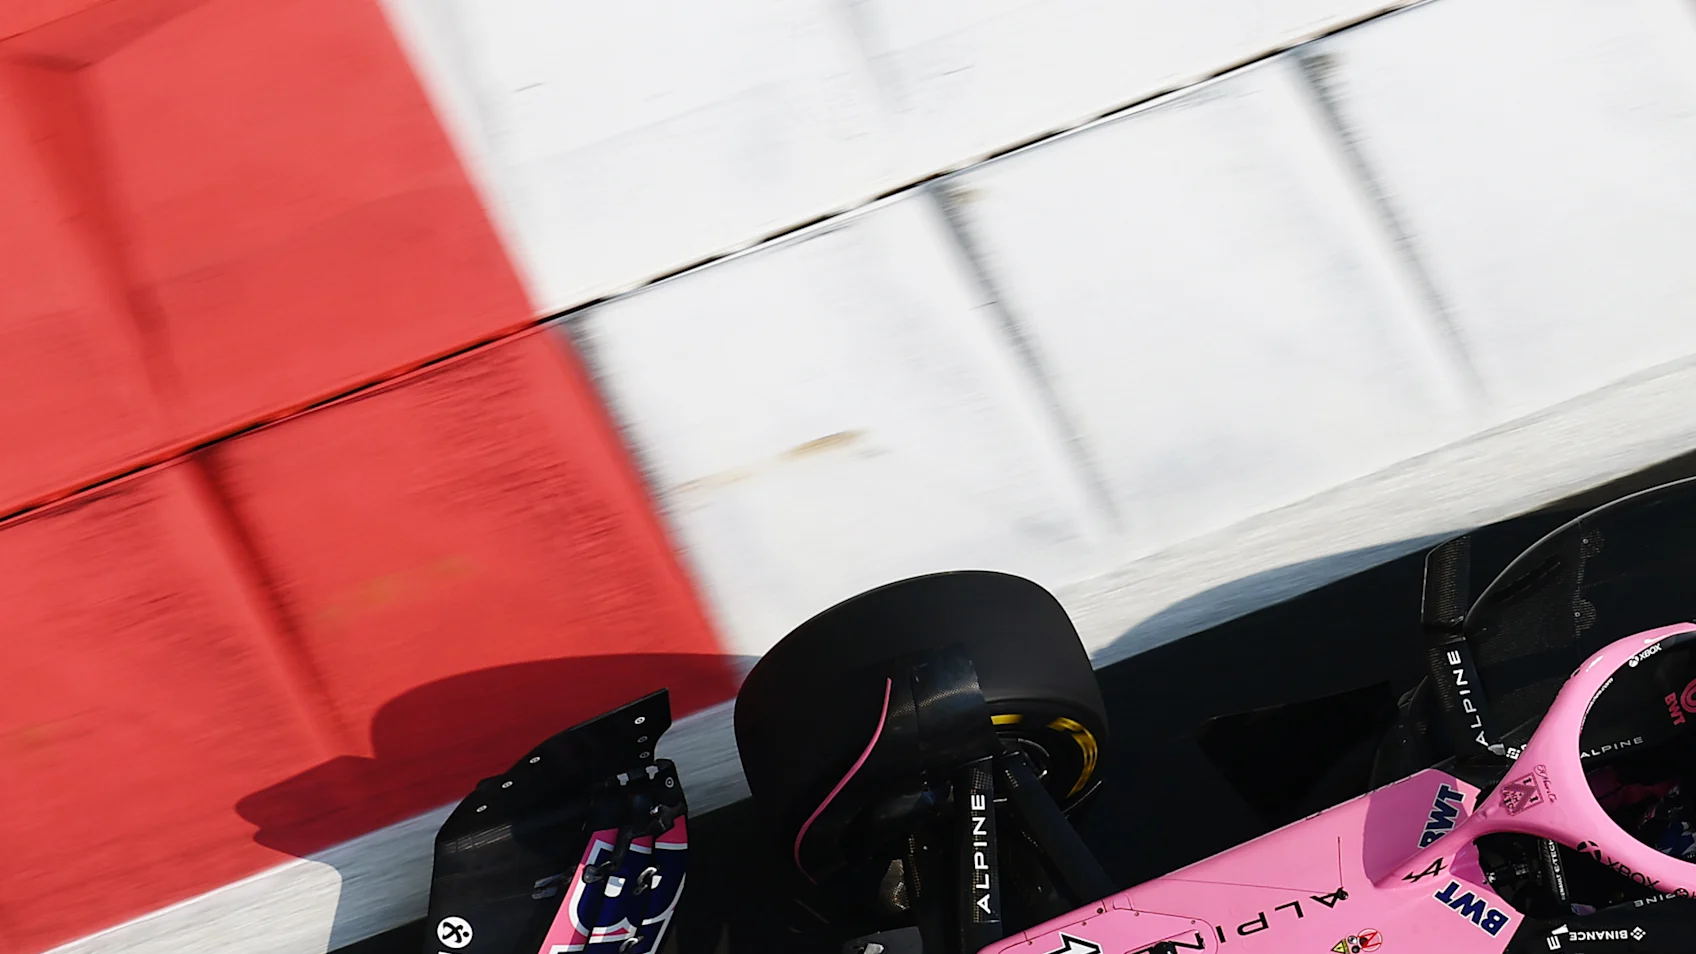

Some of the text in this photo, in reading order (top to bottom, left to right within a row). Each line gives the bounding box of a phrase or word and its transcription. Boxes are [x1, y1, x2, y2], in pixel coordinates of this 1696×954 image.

[1639, 643, 1662, 662] XBOX
[1447, 650, 1489, 747] ALPINE
[1664, 692, 1686, 726] BWT
[1580, 736, 1644, 759] ALPINE
[1417, 783, 1467, 849] BWT
[968, 793, 992, 914] ALPINE
[1605, 857, 1660, 888] XBOX
[1432, 880, 1511, 938] BWT
[1569, 929, 1628, 942] BINANCE
